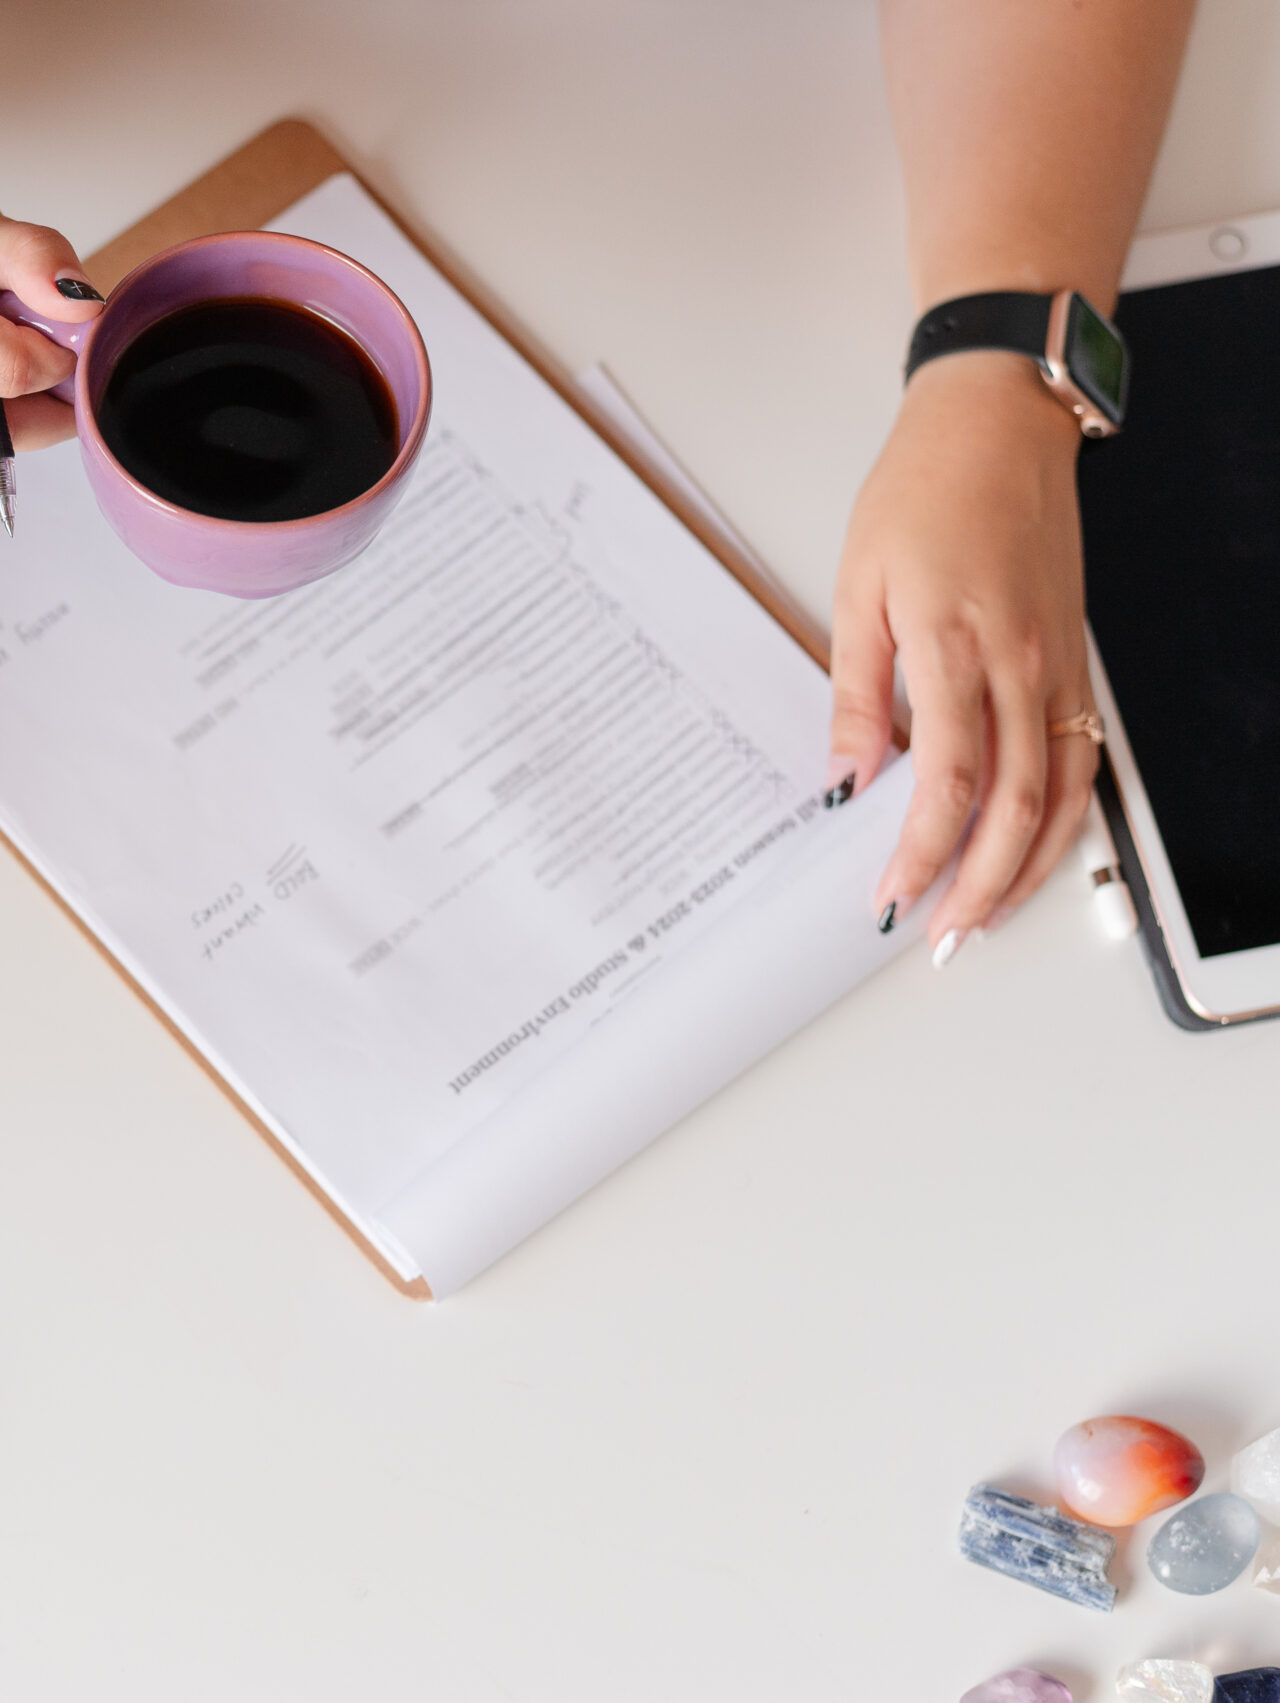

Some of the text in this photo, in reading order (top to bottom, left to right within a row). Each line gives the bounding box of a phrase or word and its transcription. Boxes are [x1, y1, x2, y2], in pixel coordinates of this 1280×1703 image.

[733, 817, 797, 868] Season
[202, 902, 265, 960] vibrant
[627, 934, 646, 952] &
[569, 950, 629, 1000] Studio
[448, 996, 571, 1096] Environment
